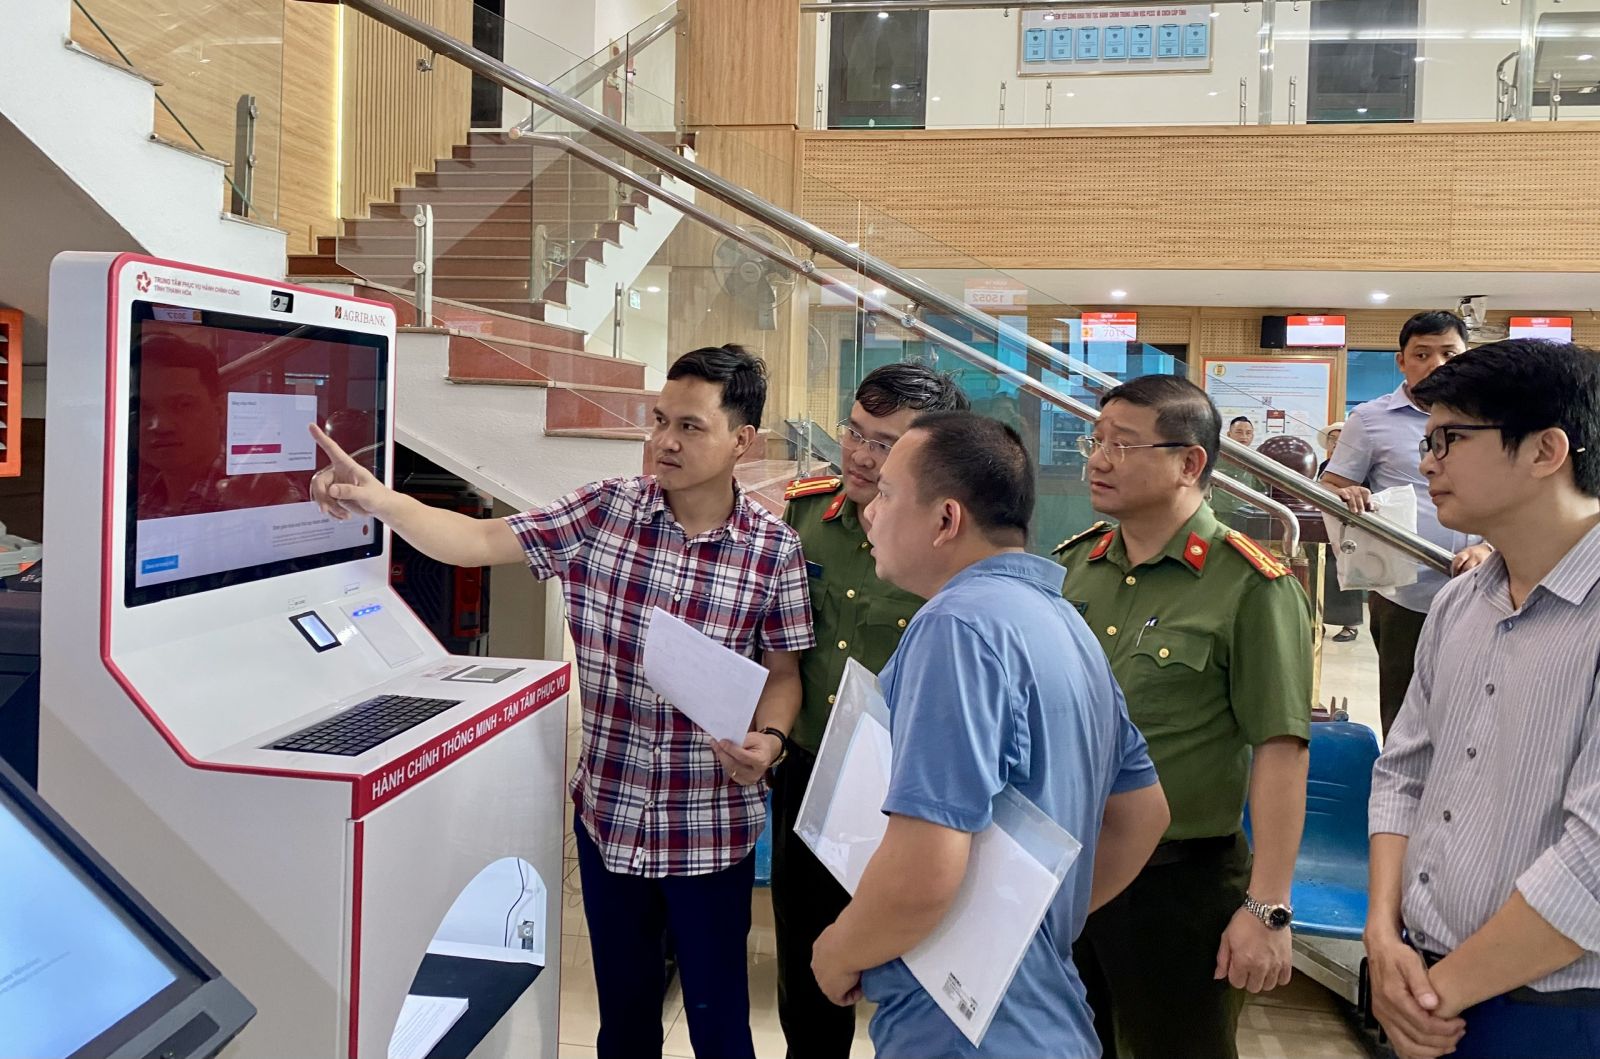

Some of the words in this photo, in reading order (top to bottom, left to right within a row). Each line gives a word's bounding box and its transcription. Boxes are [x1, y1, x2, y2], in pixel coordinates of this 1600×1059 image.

[154, 276, 171, 285] TRUNG
[171, 278, 181, 286] TÂM
[182, 281, 194, 289] PHỤC
[228, 287, 240, 296] CÔNG
[166, 286, 182, 294] THANH
[342, 309, 386, 327] AGRIBANK
[372, 772, 405, 800] HÀNH
[407, 750, 440, 779] CHÍNH
[441, 727, 475, 758] THÔNG
[475, 713, 497, 738] MINH
[503, 701, 519, 722] TẬN
[519, 691, 536, 711] TÂM
[536, 680, 556, 702] PHỤC
[556, 674, 566, 690] VỤ
